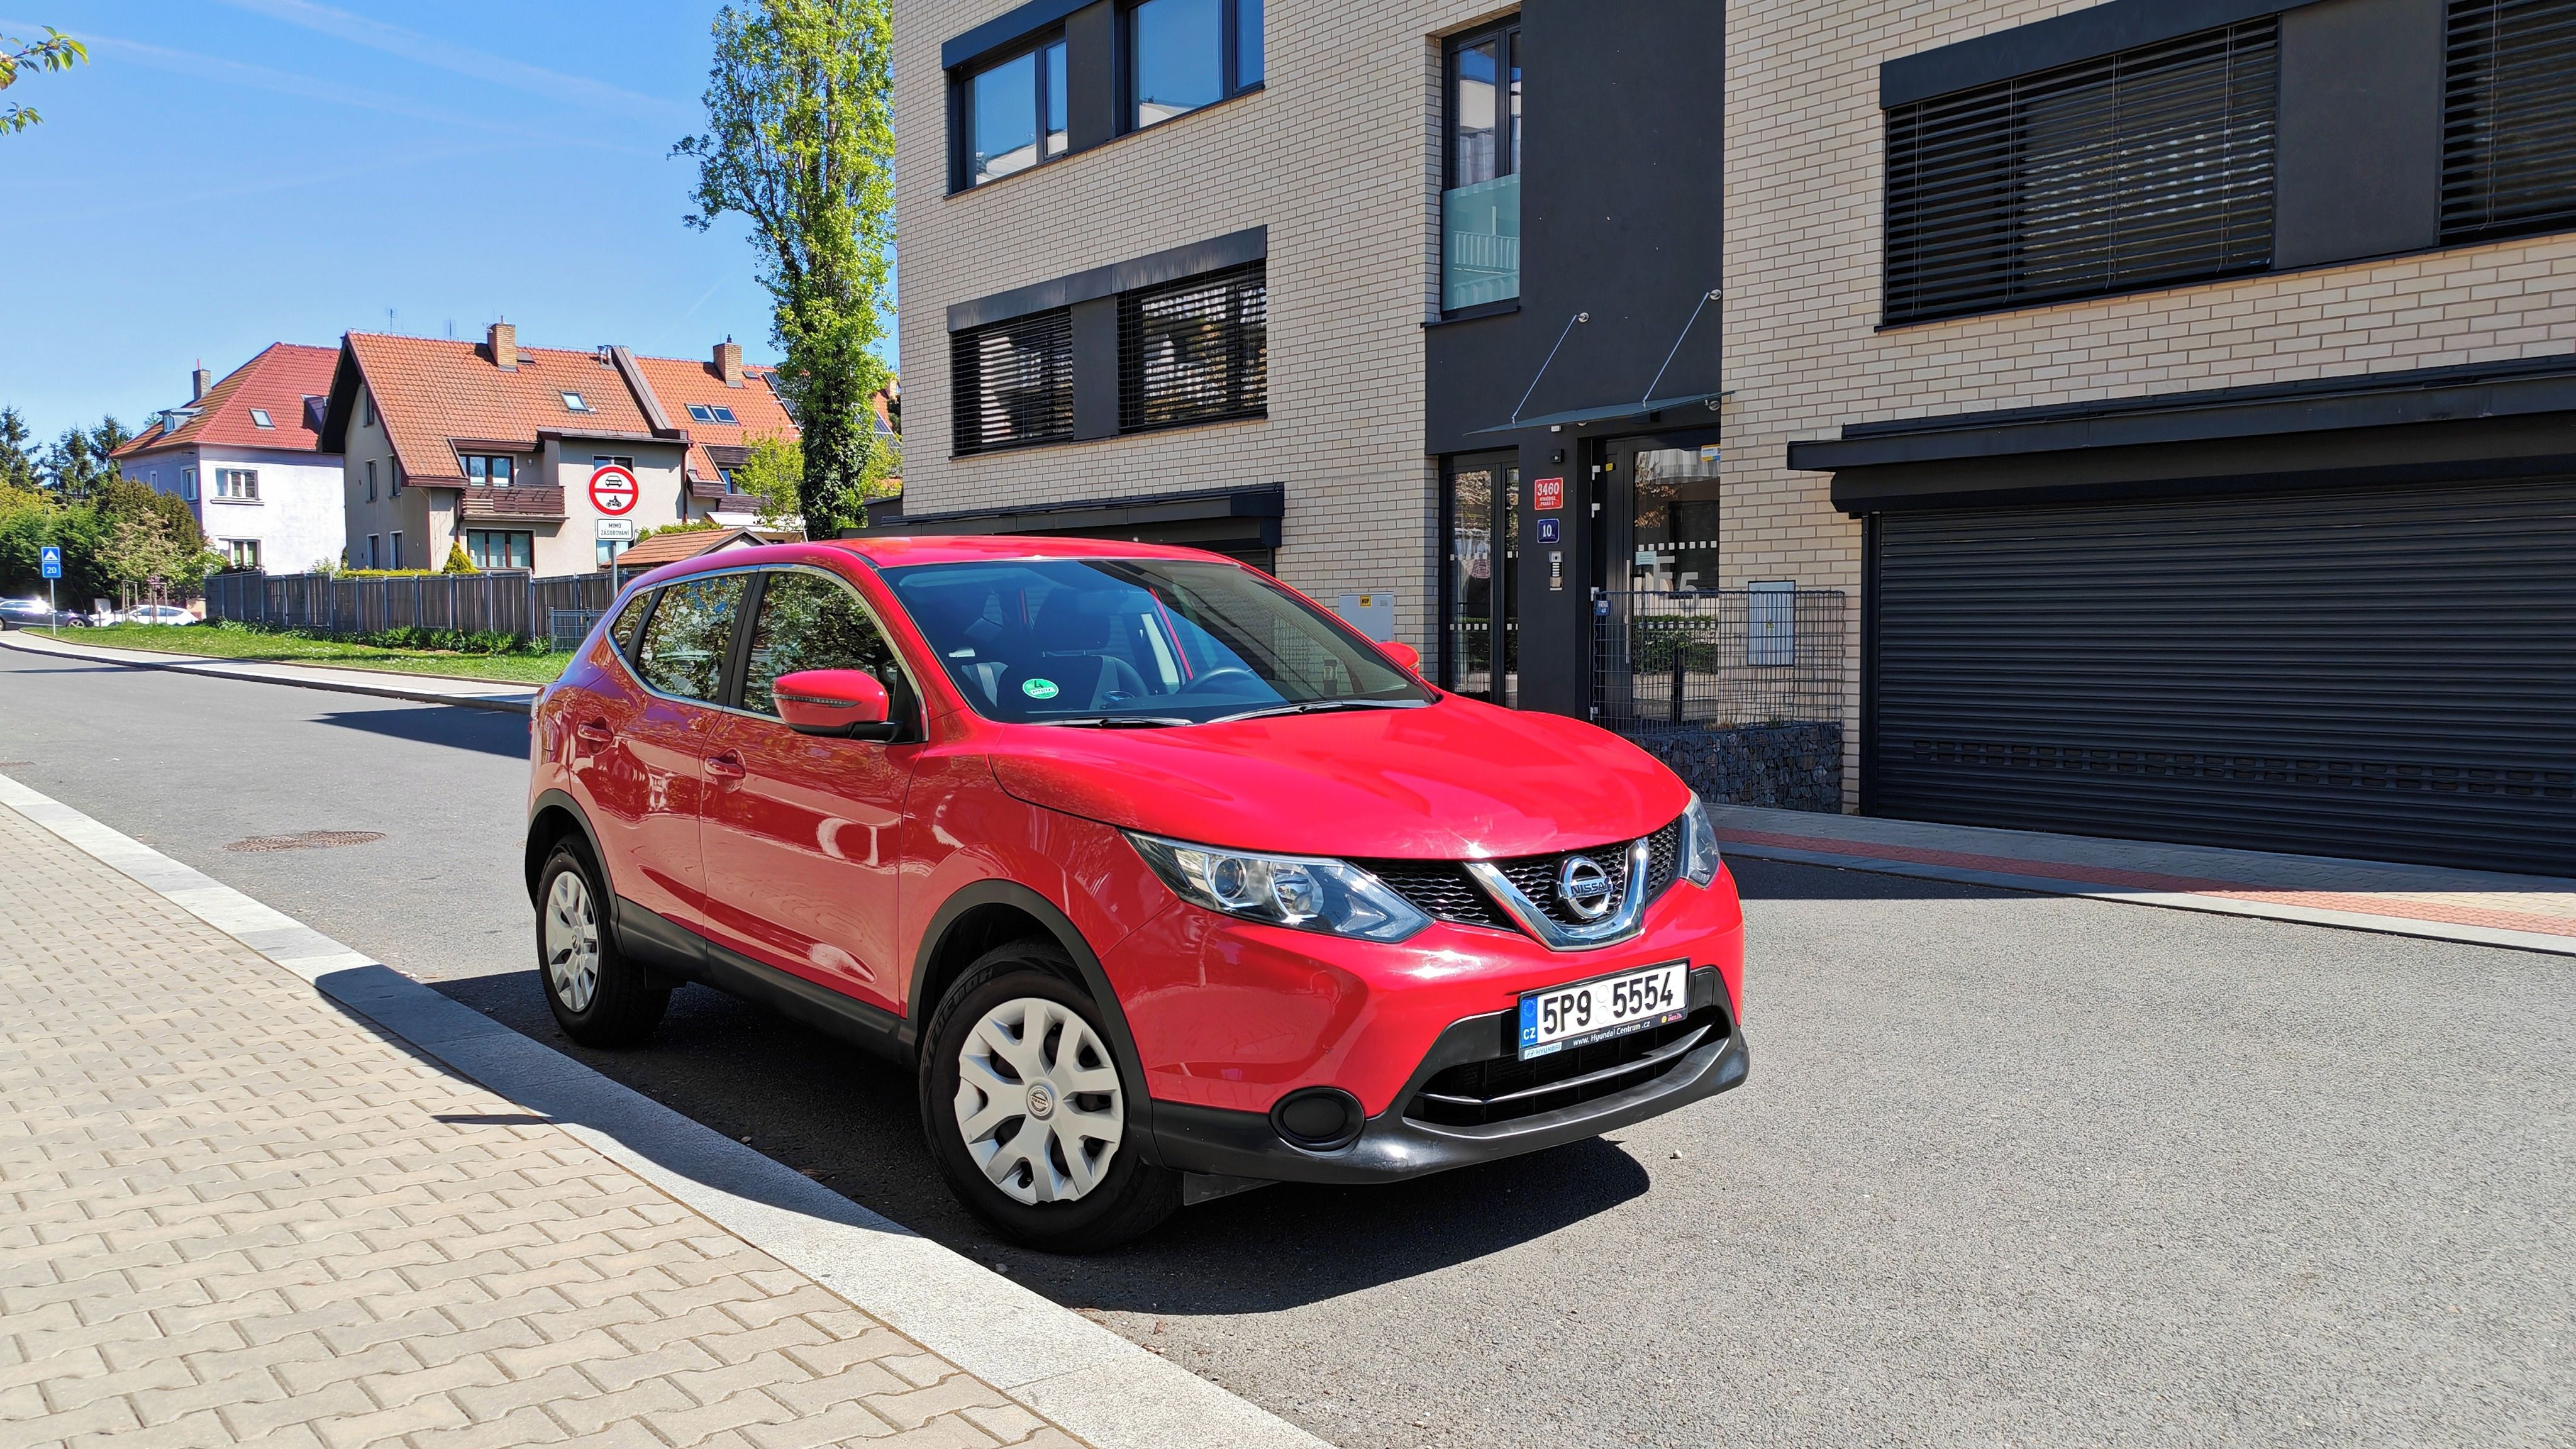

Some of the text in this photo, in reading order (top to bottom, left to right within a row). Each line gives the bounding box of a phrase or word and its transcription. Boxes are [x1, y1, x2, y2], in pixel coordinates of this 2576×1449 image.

[1537, 482, 1560, 496] 3460
[1543, 524, 1552, 537] 10
[1543, 971, 1674, 1035] 5P9 5554
[1523, 1026, 1536, 1040] CZ
[1573, 1036, 1589, 1046] www.
[1616, 1023, 1640, 1035] Centrum
[1641, 1021, 1650, 1029] .cz
[1536, 1044, 1561, 1055] HYUNDAI
